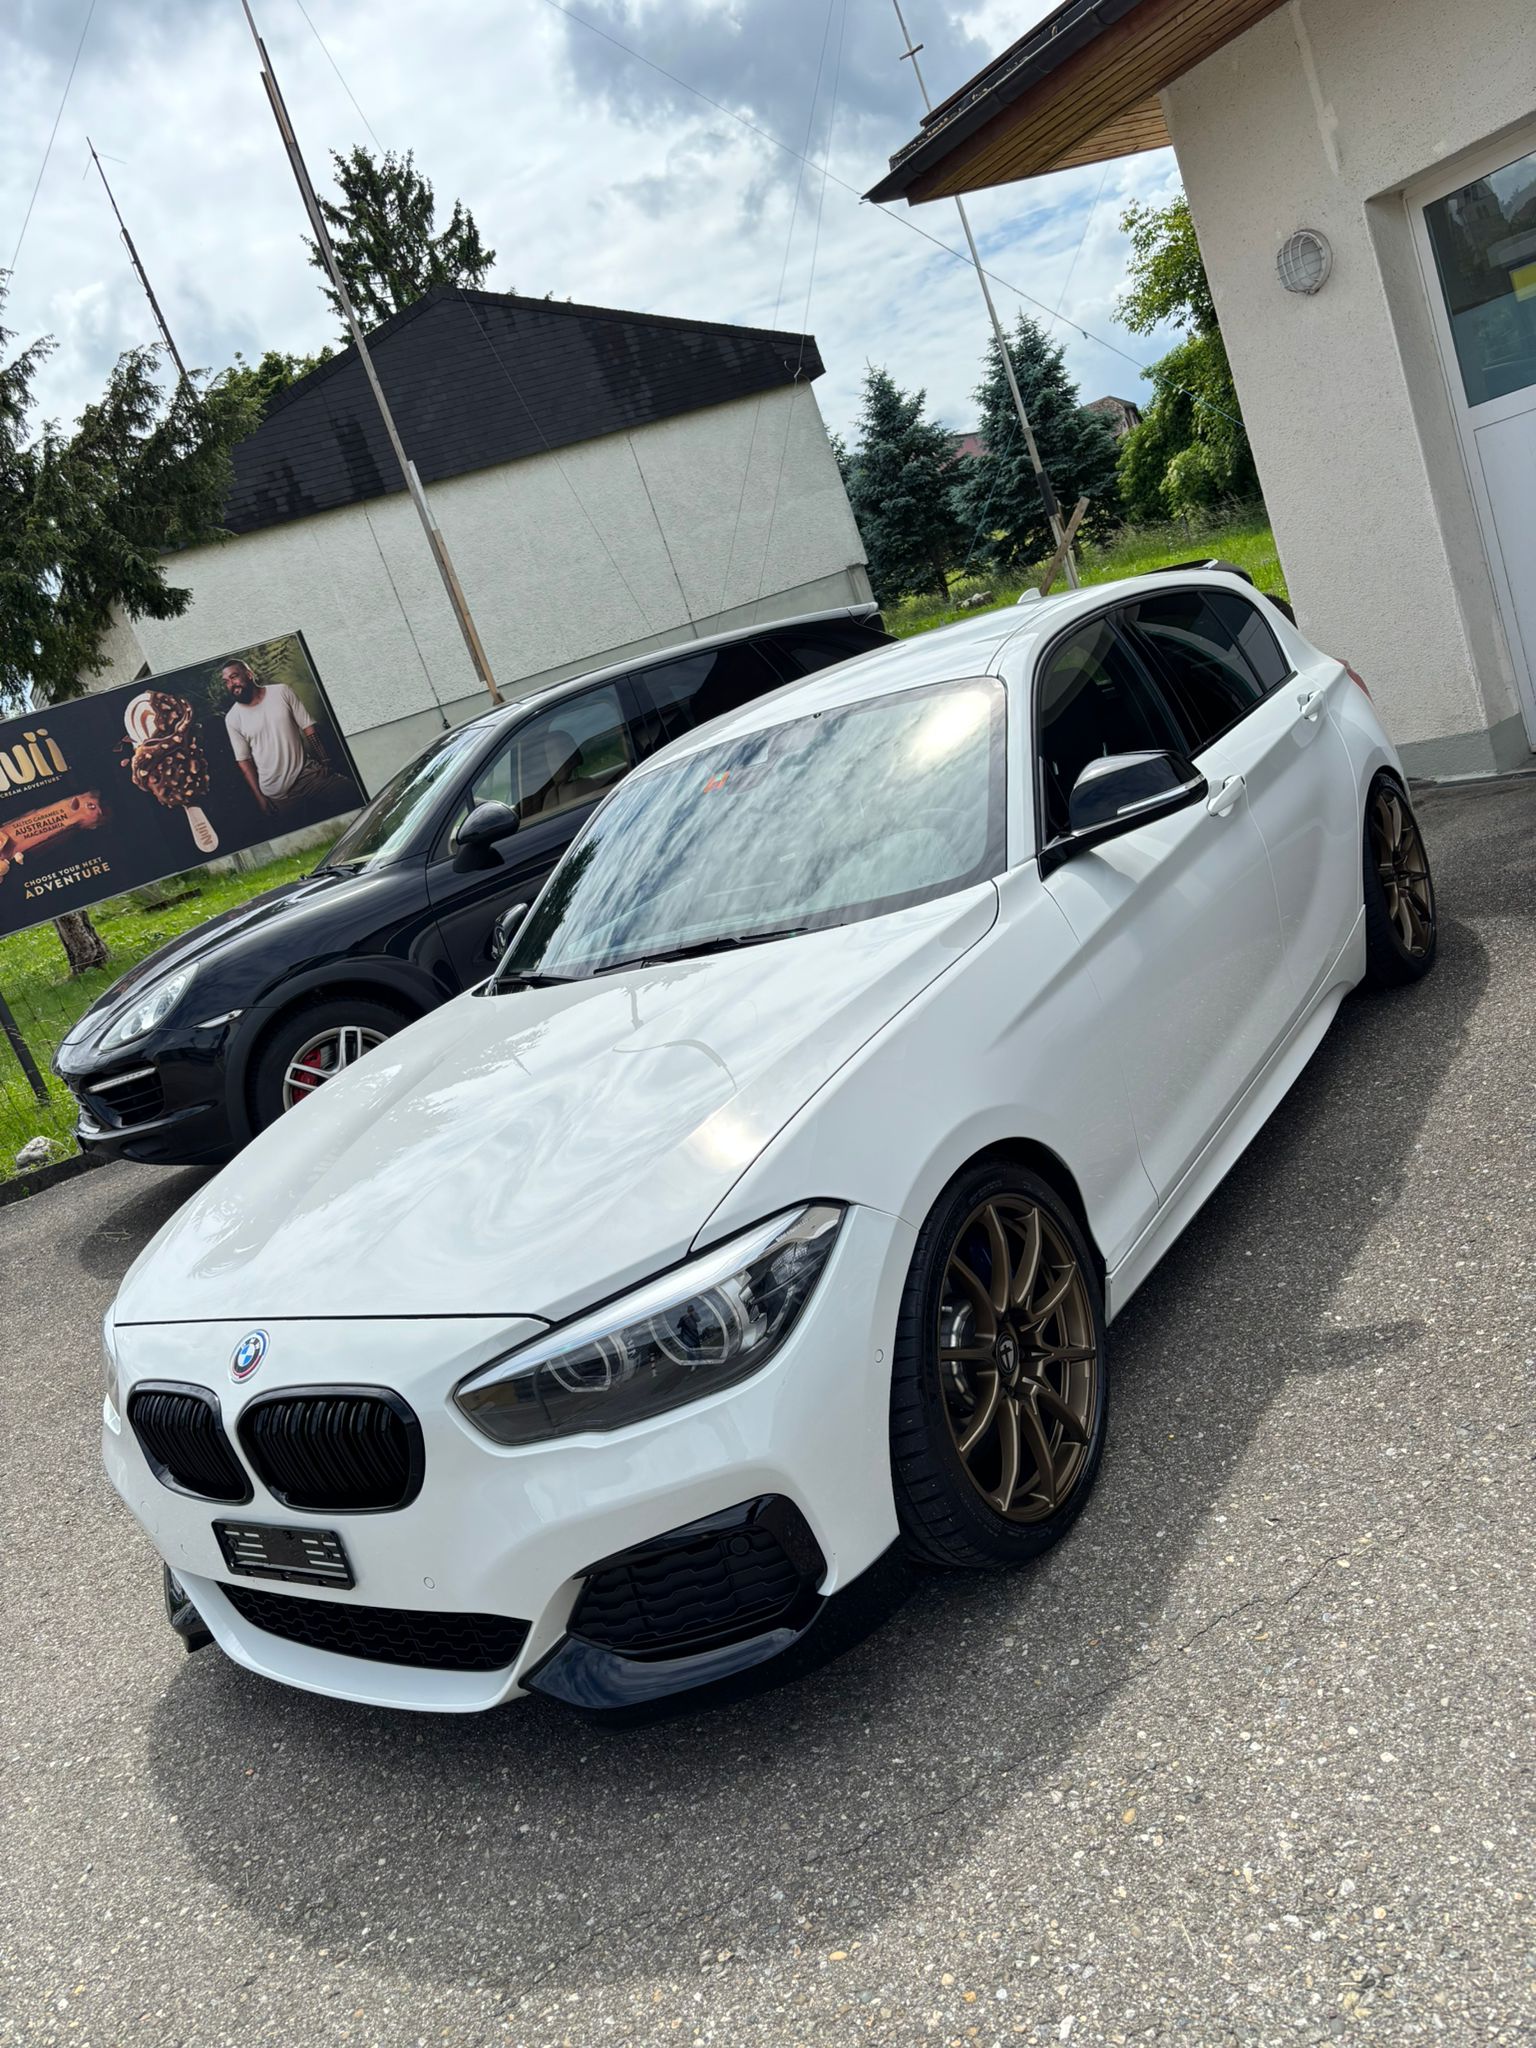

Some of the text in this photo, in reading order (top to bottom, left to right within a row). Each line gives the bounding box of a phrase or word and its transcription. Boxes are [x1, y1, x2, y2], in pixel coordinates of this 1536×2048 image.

[13, 818, 33, 829] SALTED
[33, 810, 58, 822] CARAMEL
[15, 813, 69, 836] AUSTRALIAN
[24, 822, 65, 839] MACADAMIA
[24, 856, 102, 888] CHOOSE YOUR NEXT
[25, 862, 111, 900] ADVENTURE
